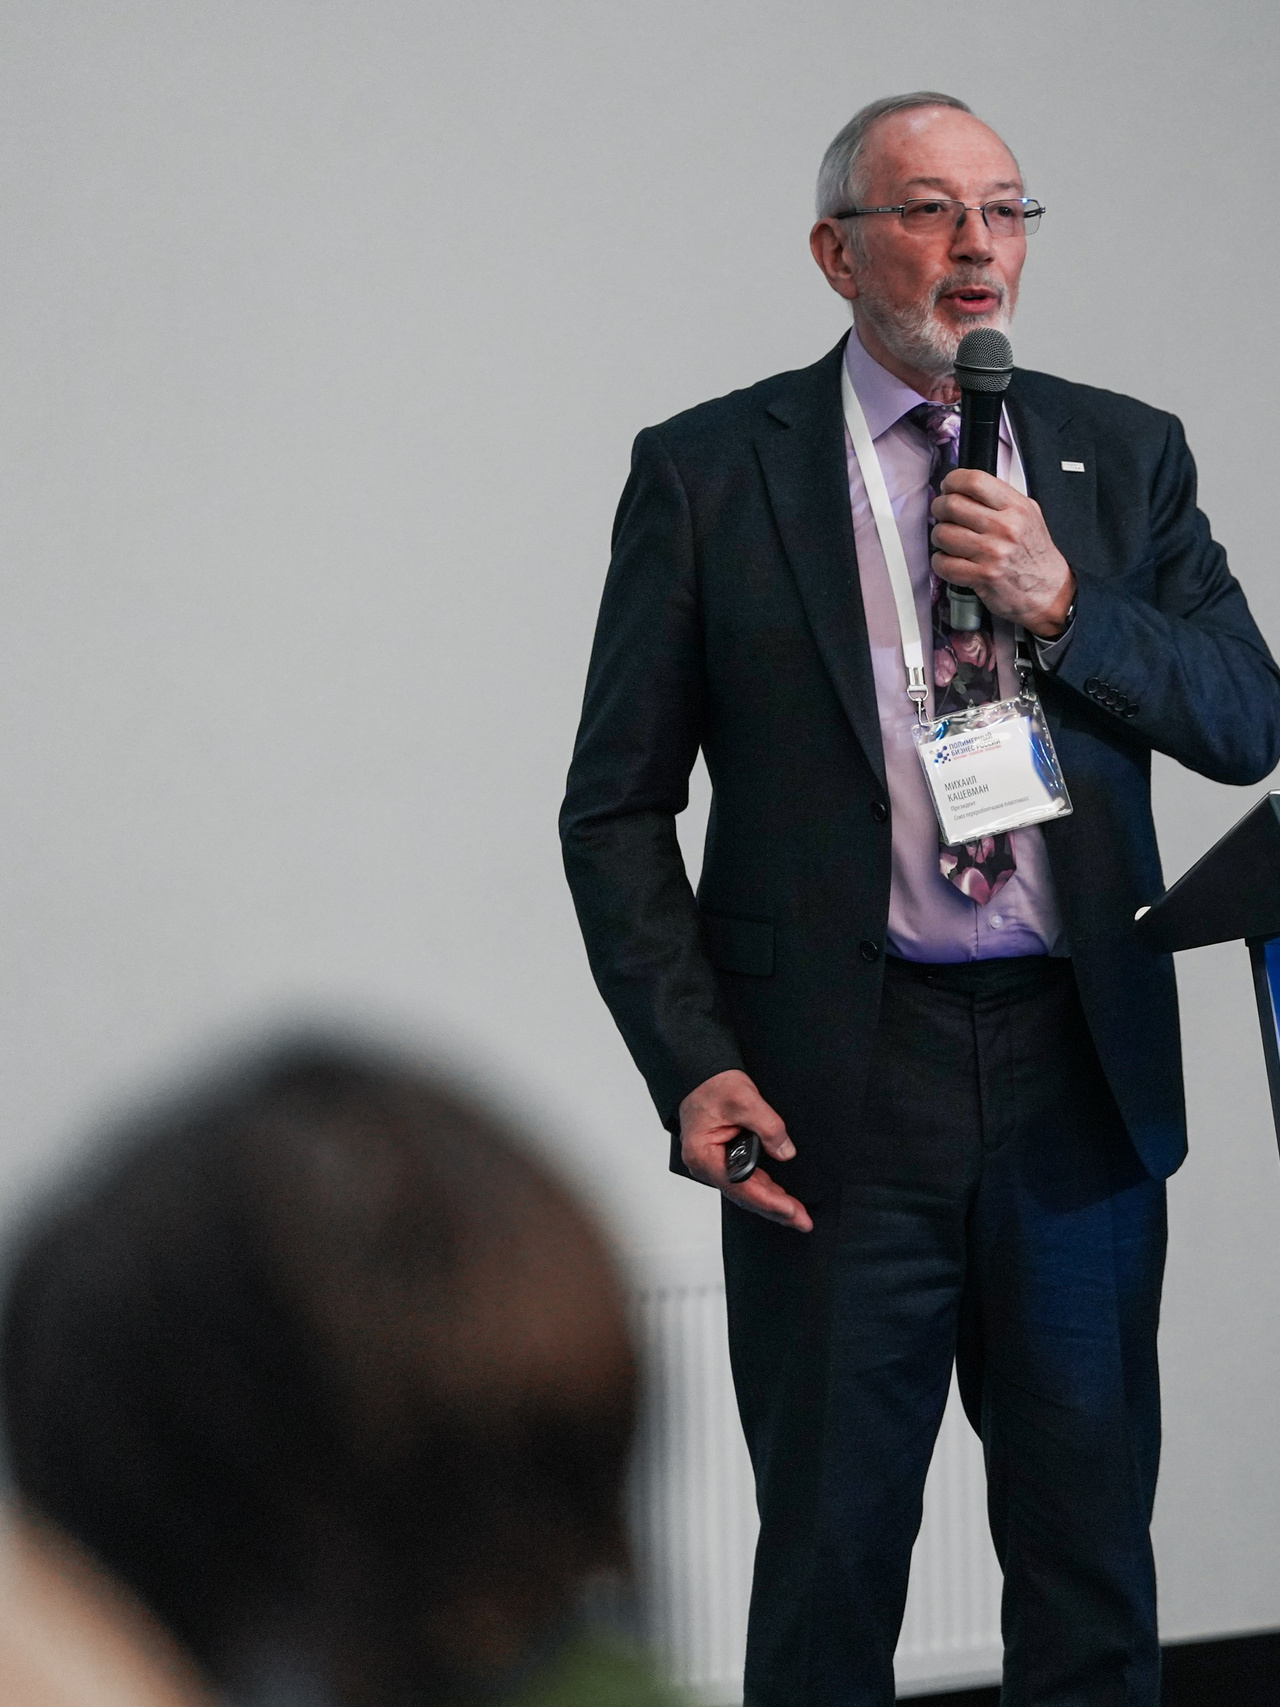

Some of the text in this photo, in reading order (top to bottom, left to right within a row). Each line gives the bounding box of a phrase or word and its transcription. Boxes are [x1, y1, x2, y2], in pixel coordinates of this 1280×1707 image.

[951, 745, 975, 757] БИЗНЕС
[944, 775, 978, 792] МИХАИЛ
[947, 784, 990, 802] КАЦЕВМАН
